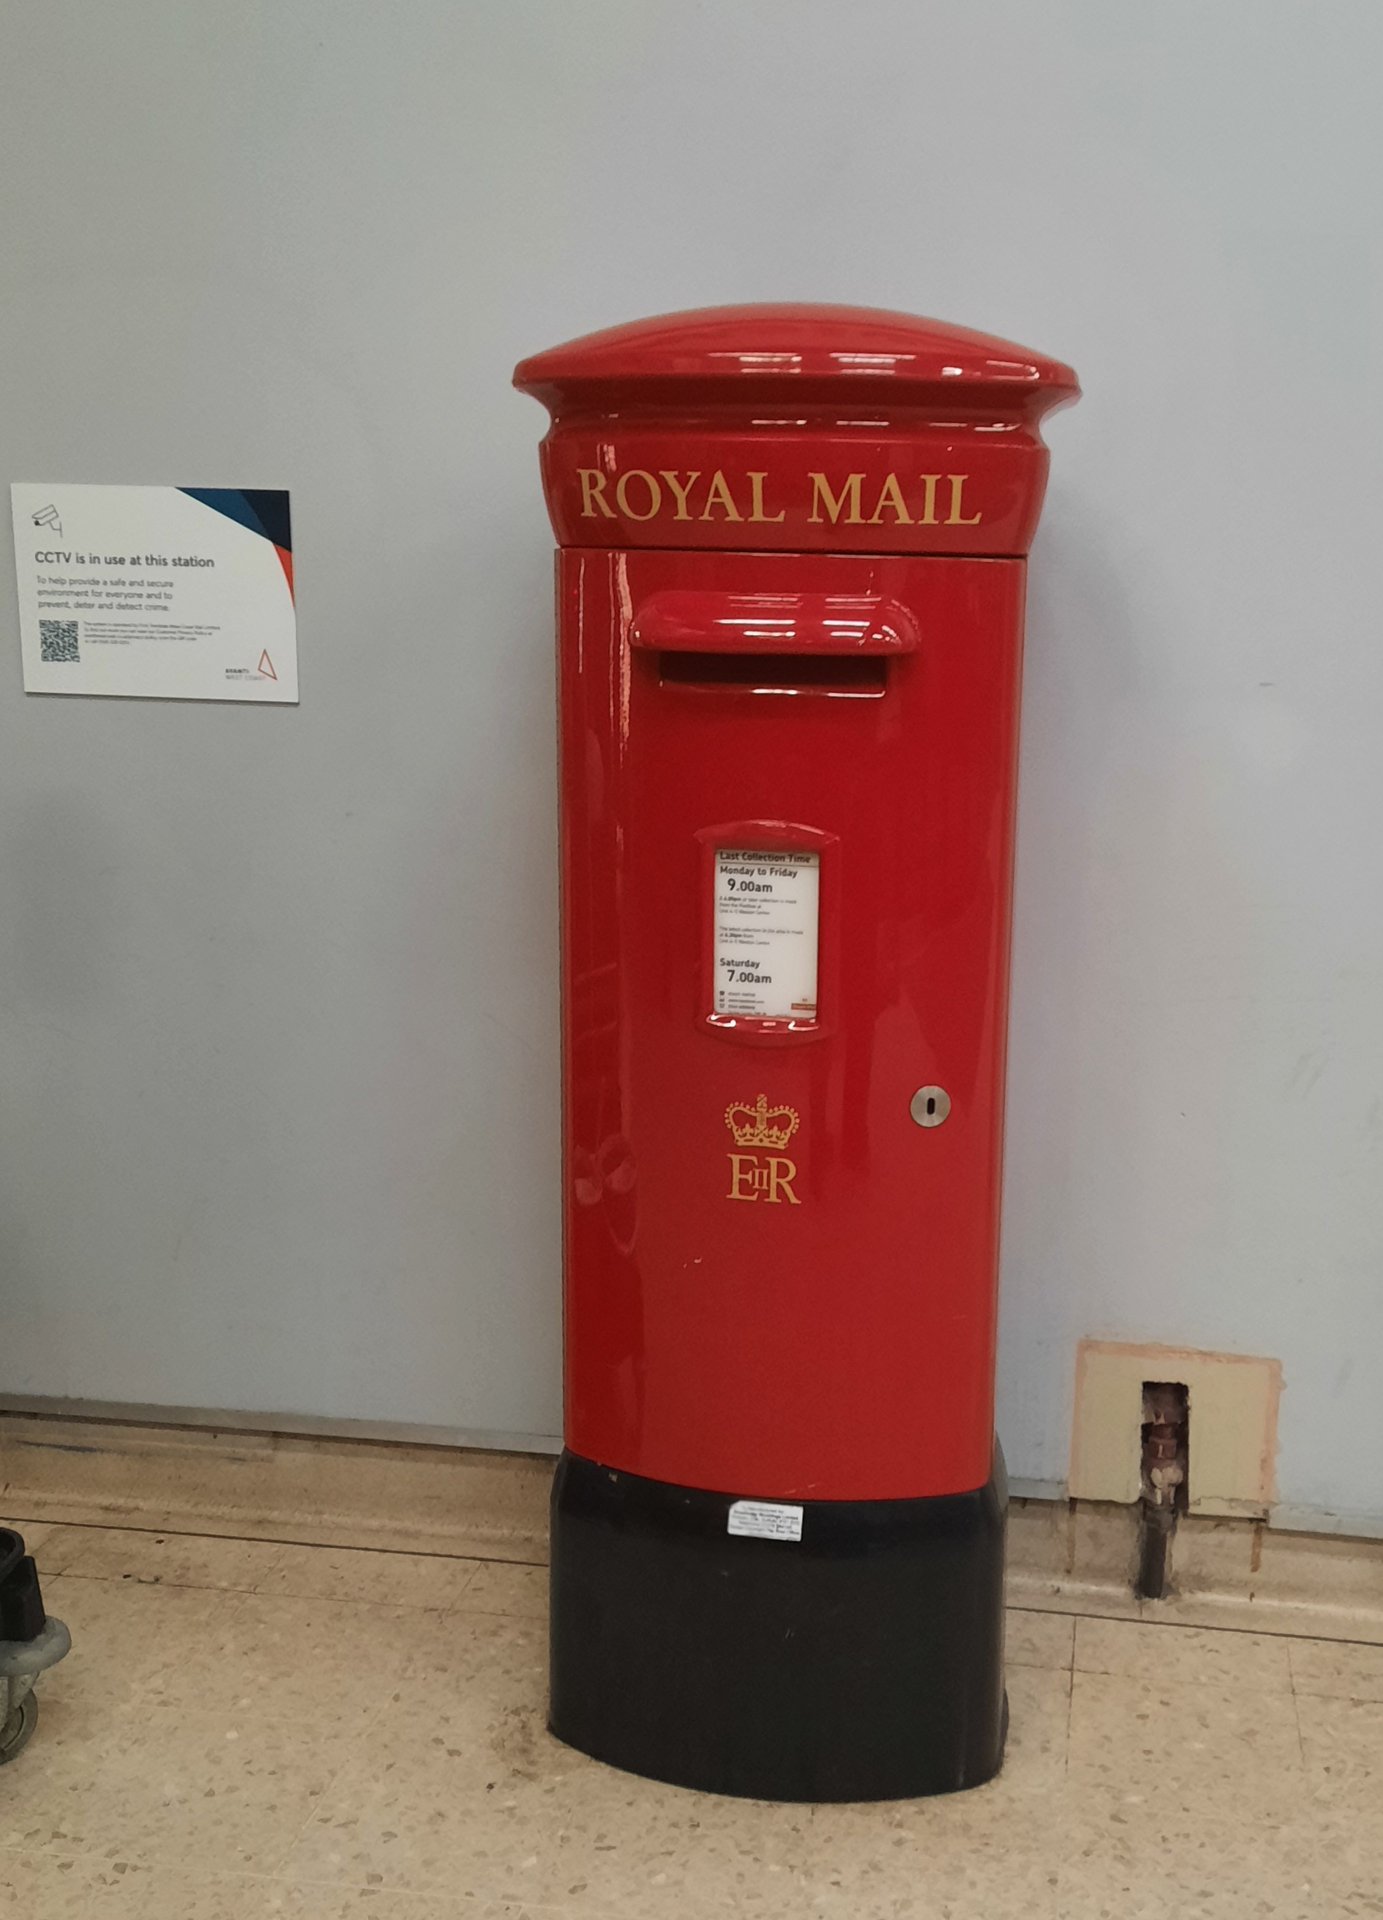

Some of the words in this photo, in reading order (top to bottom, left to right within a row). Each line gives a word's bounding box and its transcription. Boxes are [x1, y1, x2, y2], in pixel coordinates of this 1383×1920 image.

[576, 468, 786, 523] ROYAL
[806, 472, 983, 526] MAIL
[35, 551, 72, 563] CCTV
[75, 552, 86, 564] is
[89, 553, 101, 565] in
[104, 555, 126, 566] use
[129, 555, 142, 566] at
[145, 554, 168, 567] this
[171, 555, 215, 568] station
[36, 575, 46, 584] To
[48, 577, 66, 587] help
[69, 577, 100, 588] provide
[110, 578, 126, 587] safe
[128, 579, 144, 588] and
[147, 581, 174, 589] secure
[37, 589, 89, 598] environment
[91, 589, 103, 598] for
[105, 590, 144, 601] everyone
[146, 591, 162, 600] and
[164, 591, 173, 600] to
[73, 600, 95, 609] deter
[98, 600, 114, 610] and
[115, 602, 143, 611] detect
[720, 851, 739, 861] Last
[742, 852, 785, 862] Collection
[788, 854, 811, 863] Time
[720, 866, 755, 877] Monday
[757, 867, 767, 876] to
[769, 868, 798, 879] Friday
[727, 878, 773, 893] 9.00am
[720, 957, 760, 969] Saturday
[727, 969, 772, 984] 7.00am
